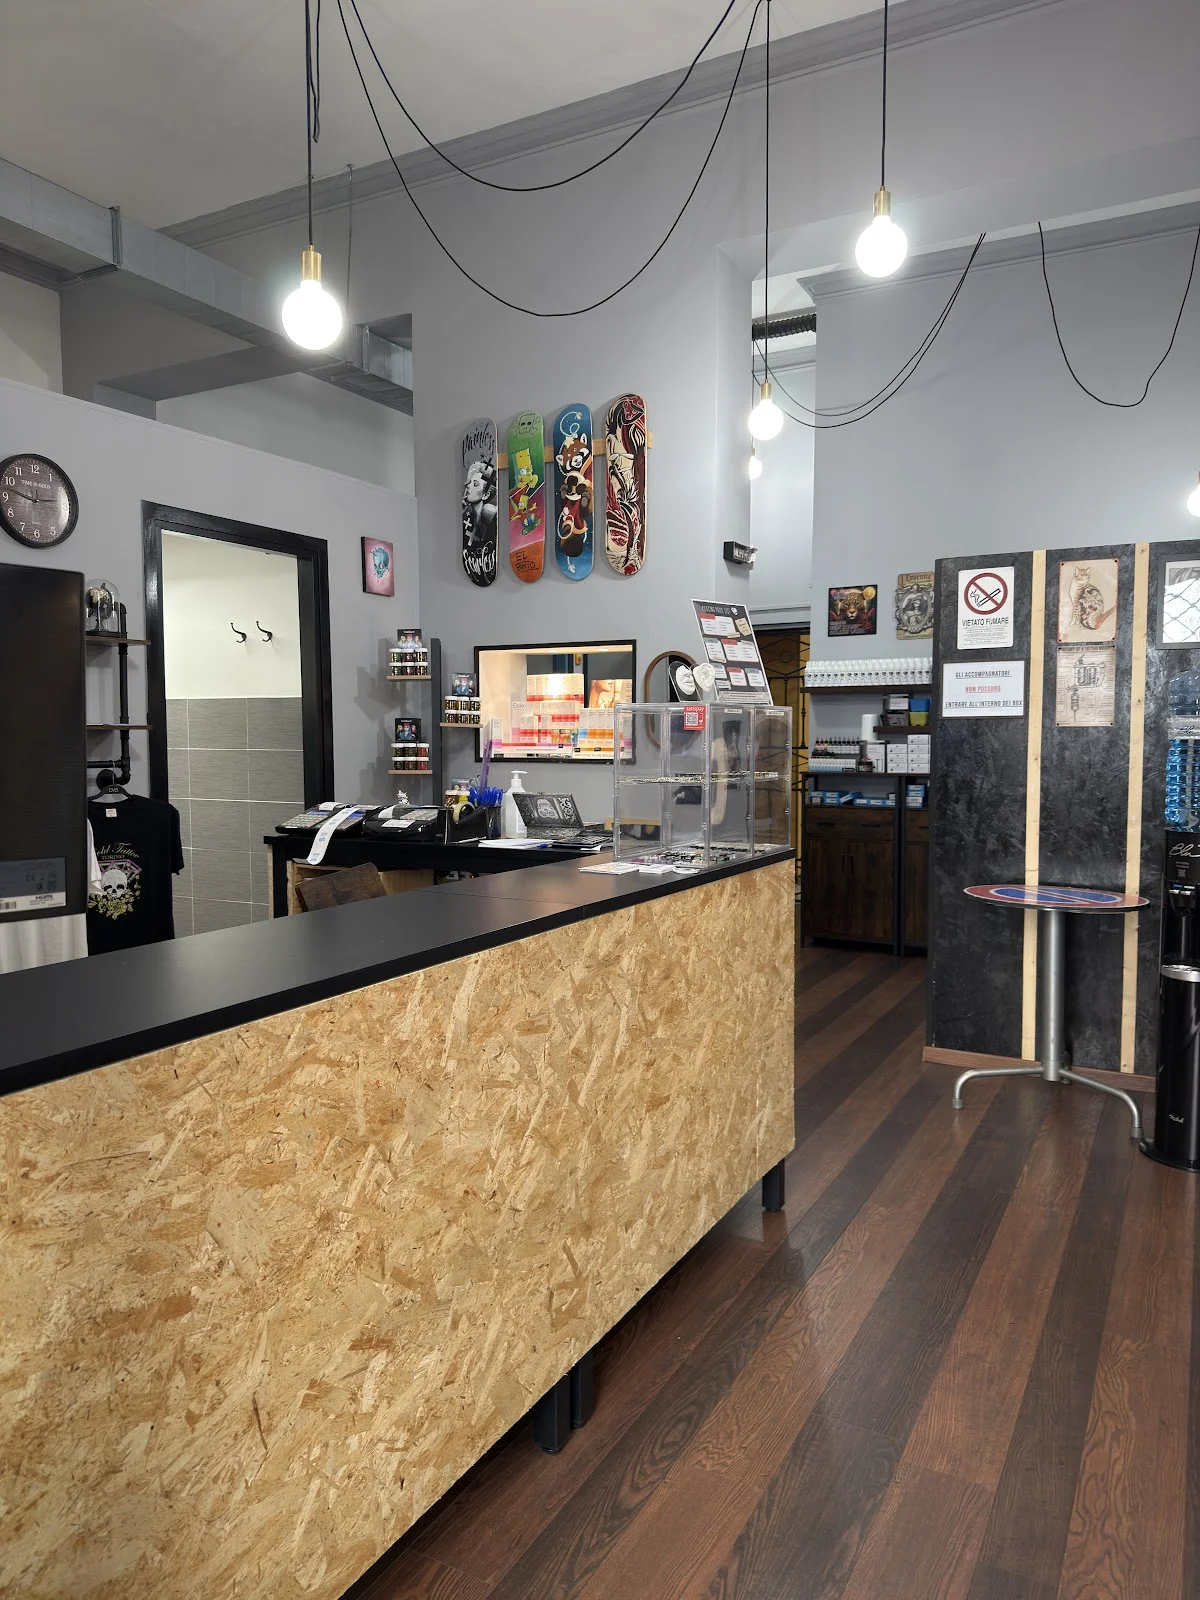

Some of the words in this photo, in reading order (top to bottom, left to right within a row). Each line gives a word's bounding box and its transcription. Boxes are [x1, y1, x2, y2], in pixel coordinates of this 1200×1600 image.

[15, 466, 23, 476] 11
[30, 464, 40, 474] 12
[5, 476, 16, 486] 10
[48, 473, 52, 482] 1
[2, 491, 9, 502] 9
[7, 507, 15, 518] 8
[20, 522, 25, 531] 7
[50, 526, 56, 536] 5
[33, 529, 40, 538] 6
[516, 551, 528, 561] EL
[962, 618, 985, 627] VIETATO
[985, 616, 1009, 625] FUMARE
[964, 670, 1010, 678] ACCOMPAGNATORI
[968, 700, 1001, 708] ALL'INTERNO
[96, 844, 111, 856] old
[111, 842, 140, 858] Tattoo
